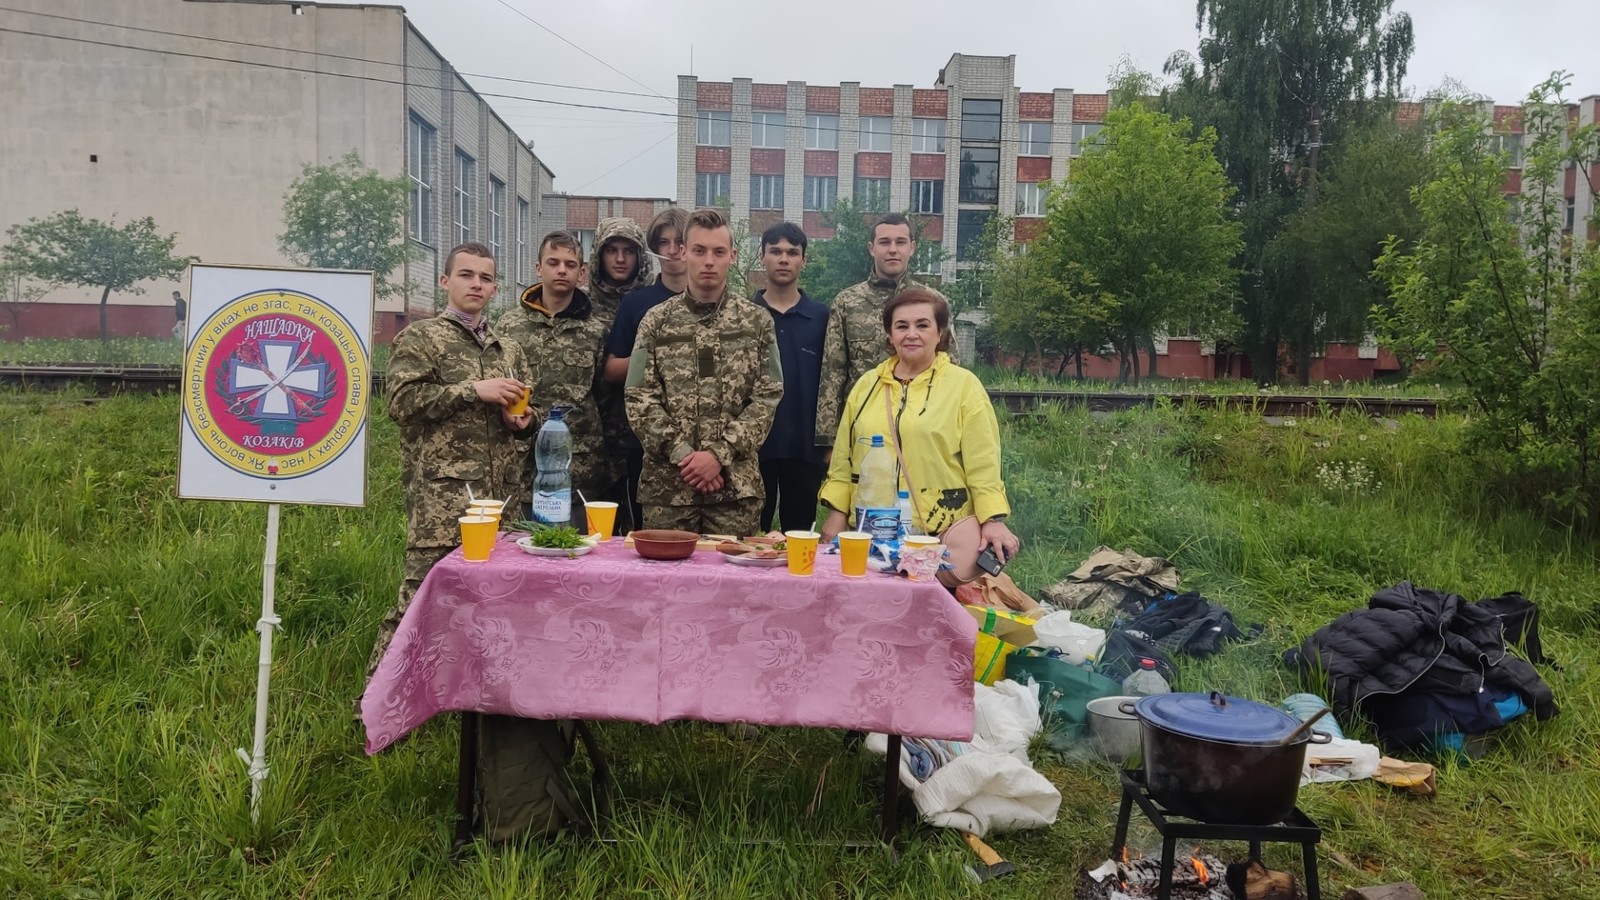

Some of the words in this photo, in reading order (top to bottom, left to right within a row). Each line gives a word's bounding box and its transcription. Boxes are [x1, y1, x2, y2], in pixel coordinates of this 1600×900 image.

[243, 303, 258, 314] не
[263, 300, 292, 311] згас,
[298, 304, 318, 318] так
[213, 310, 241, 334] віках
[244, 318, 316, 343] НАЩАДКИ
[206, 334, 216, 344] у
[319, 314, 357, 364] козацька
[192, 345, 210, 429] безсмертний
[351, 367, 361, 406] слава
[346, 408, 356, 417] у
[243, 435, 304, 449] КОЗАКІВ
[316, 420, 351, 456] серцях
[210, 430, 246, 461] вогонь
[281, 457, 305, 468] нас
[308, 450, 316, 461] у
[248, 457, 265, 470] Як
